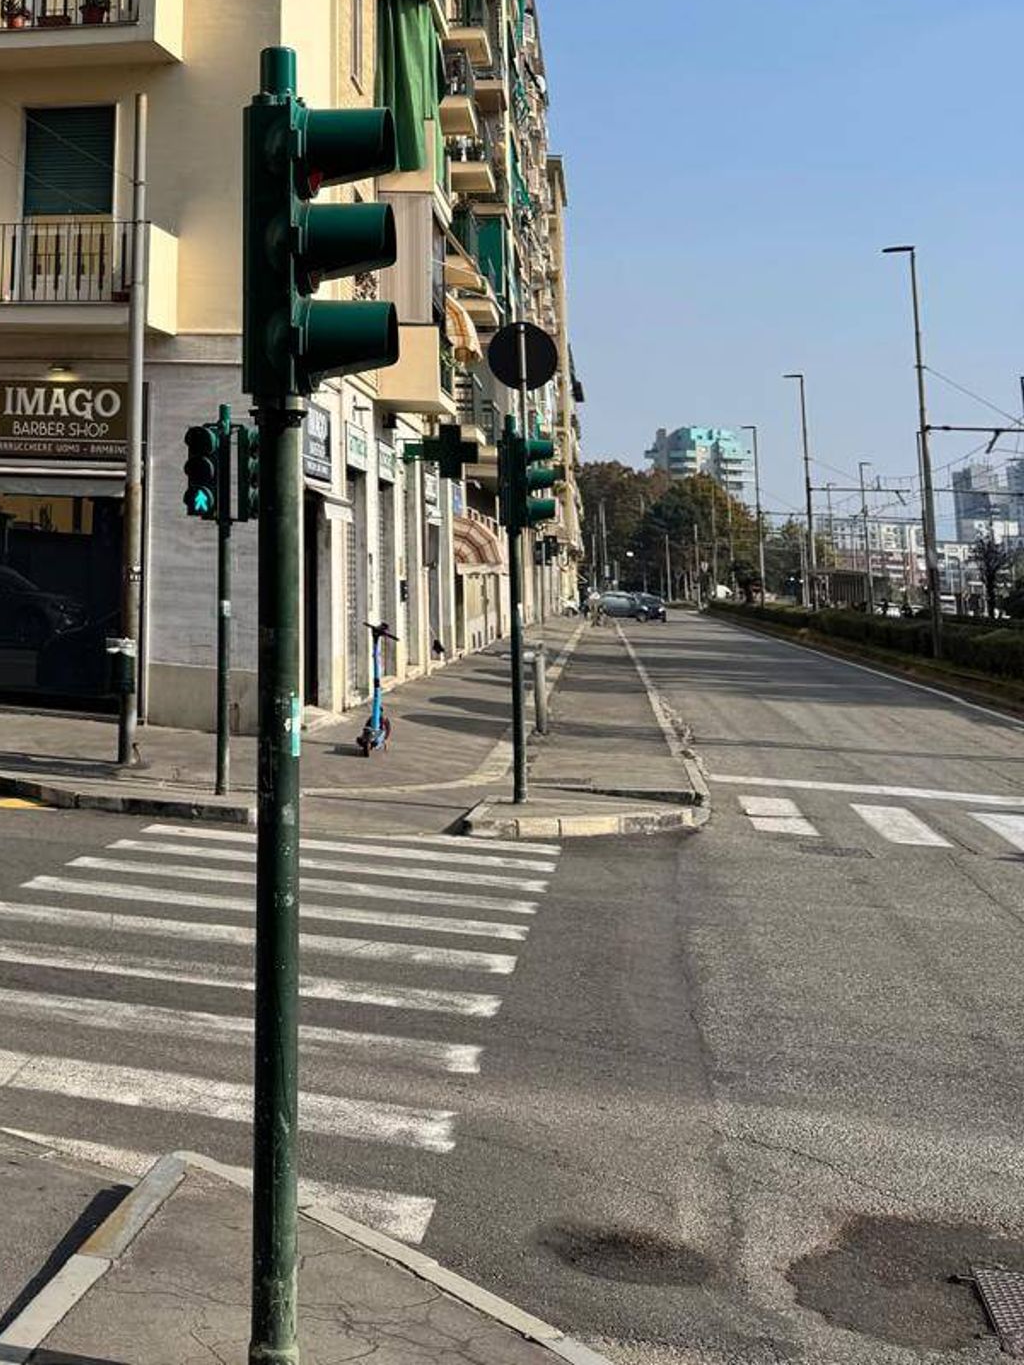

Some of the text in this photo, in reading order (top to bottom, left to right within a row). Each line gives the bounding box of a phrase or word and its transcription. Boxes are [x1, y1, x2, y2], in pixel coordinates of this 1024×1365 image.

[3, 386, 121, 421] IMAGO
[13, 421, 109, 437] BARBER SHOP
[56, 443, 80, 453] UOMO
